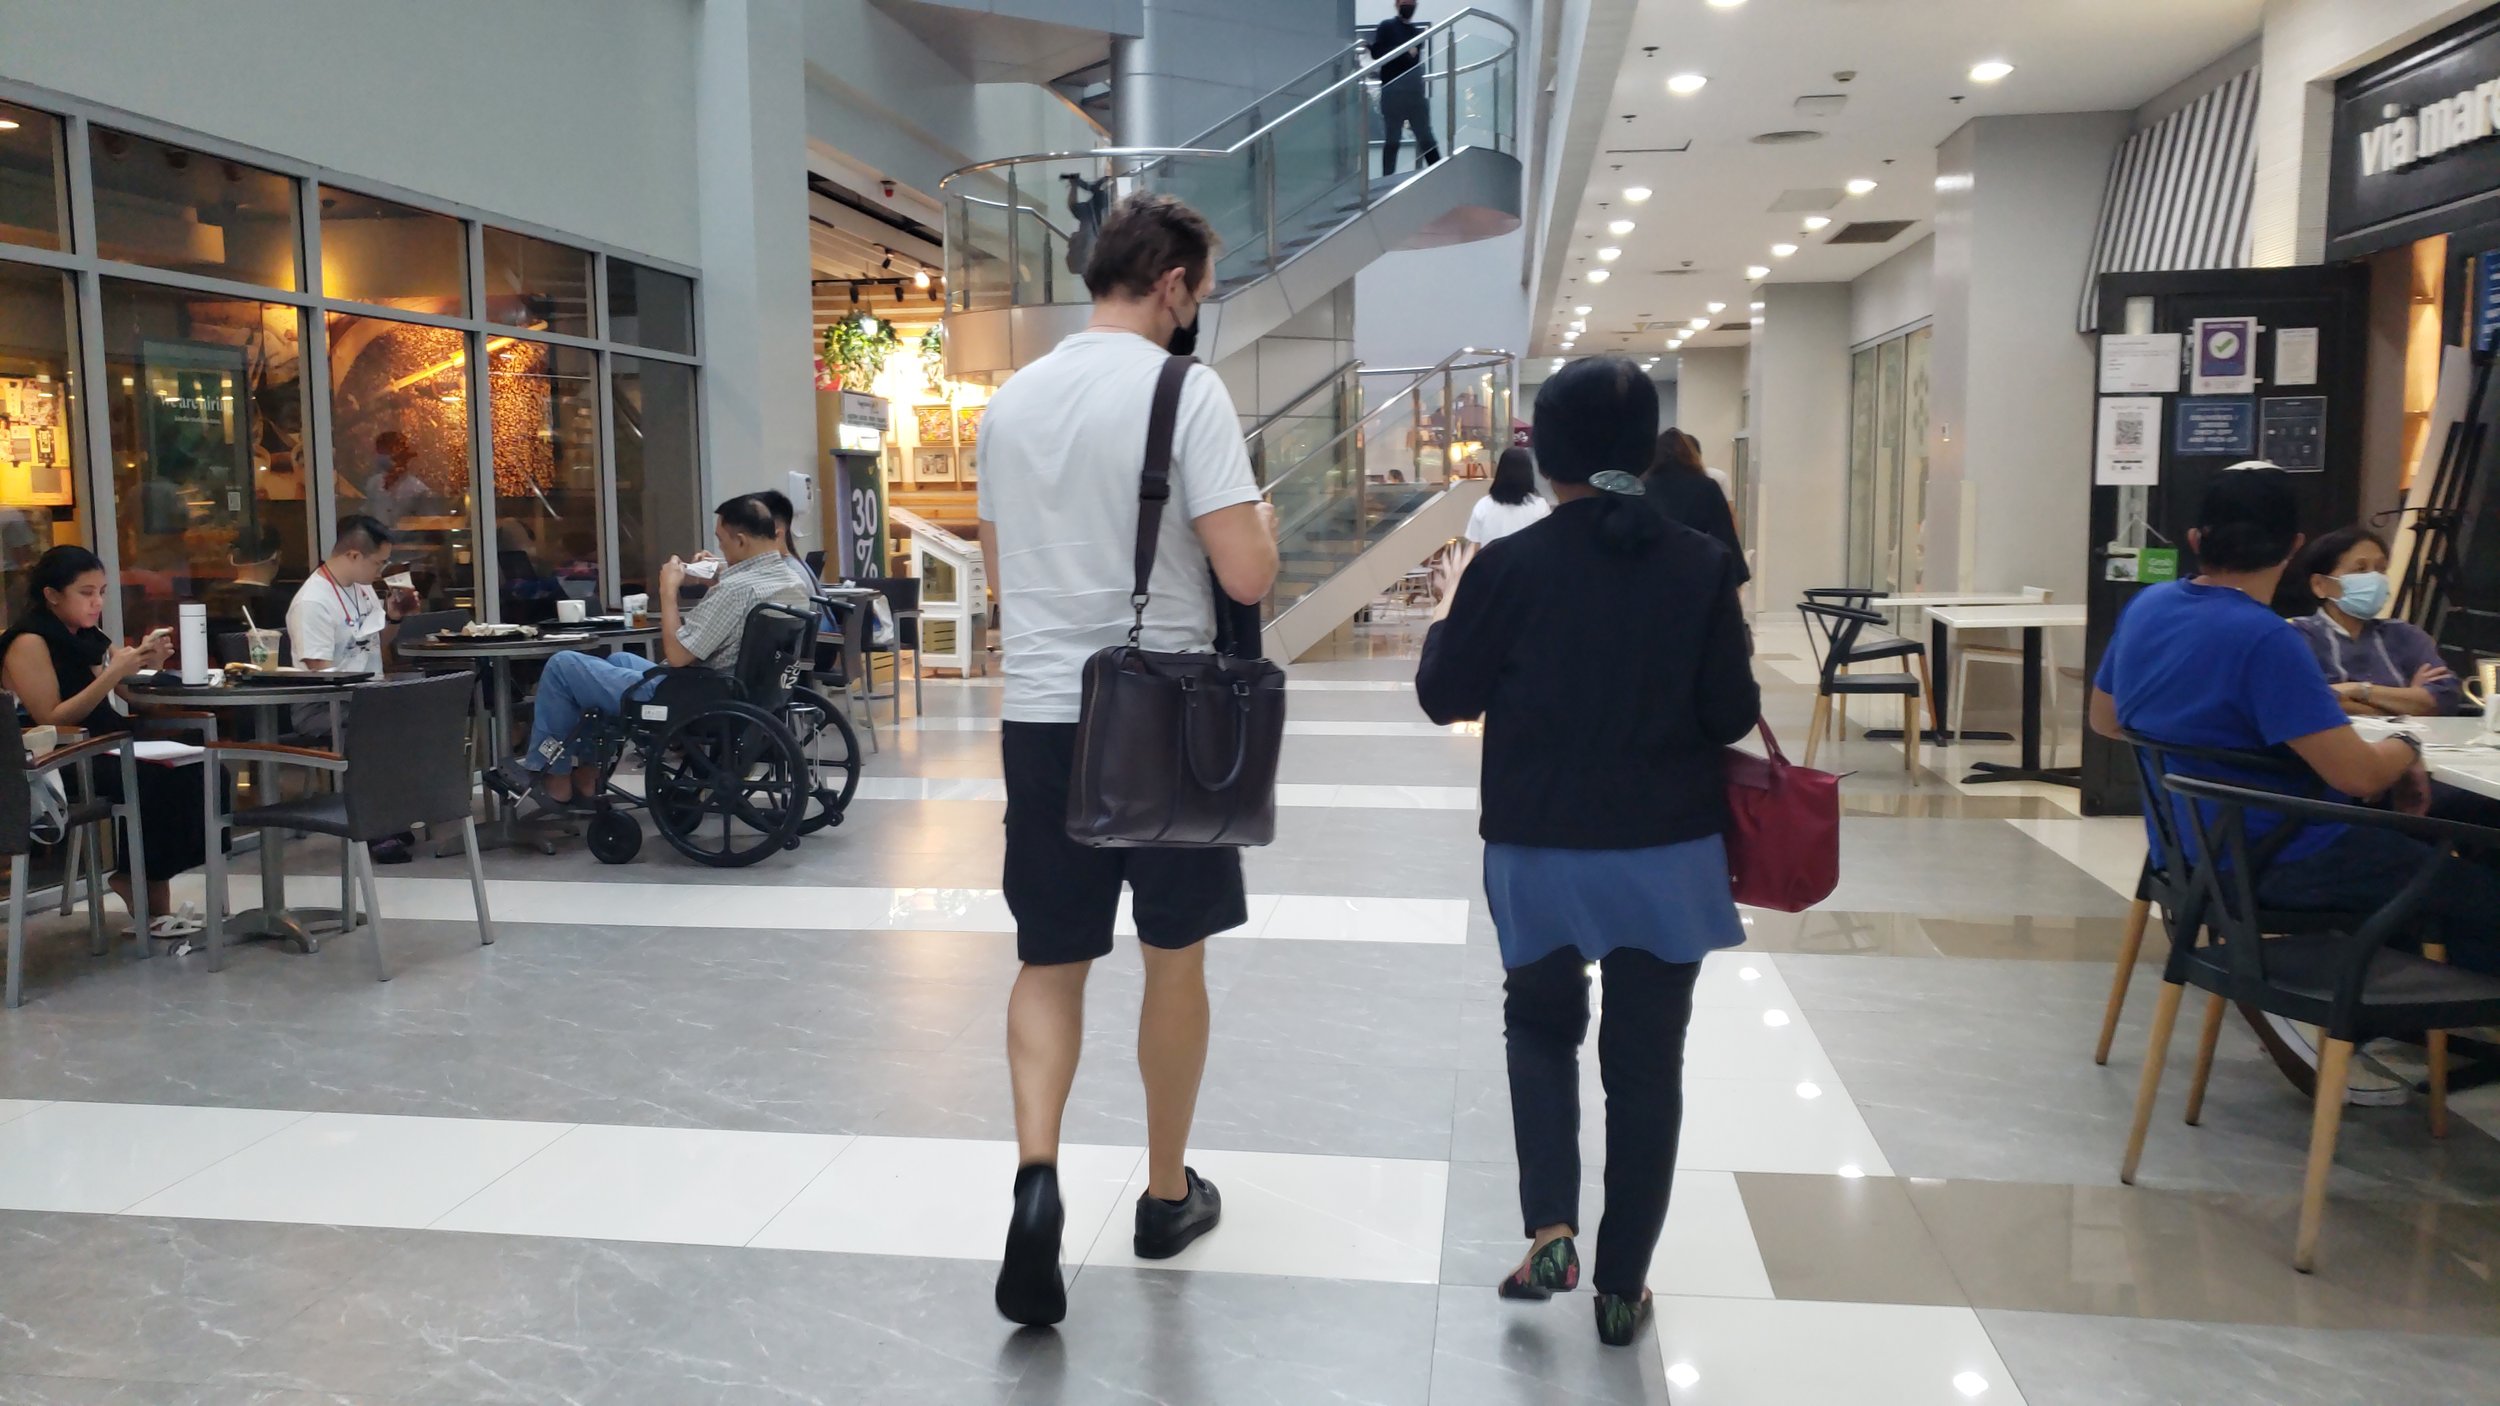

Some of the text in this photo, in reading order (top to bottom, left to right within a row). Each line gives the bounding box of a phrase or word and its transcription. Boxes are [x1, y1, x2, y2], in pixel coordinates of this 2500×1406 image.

[2360, 103, 2418, 176] via
[180, 397, 198, 410] are
[852, 488, 878, 536] 30
